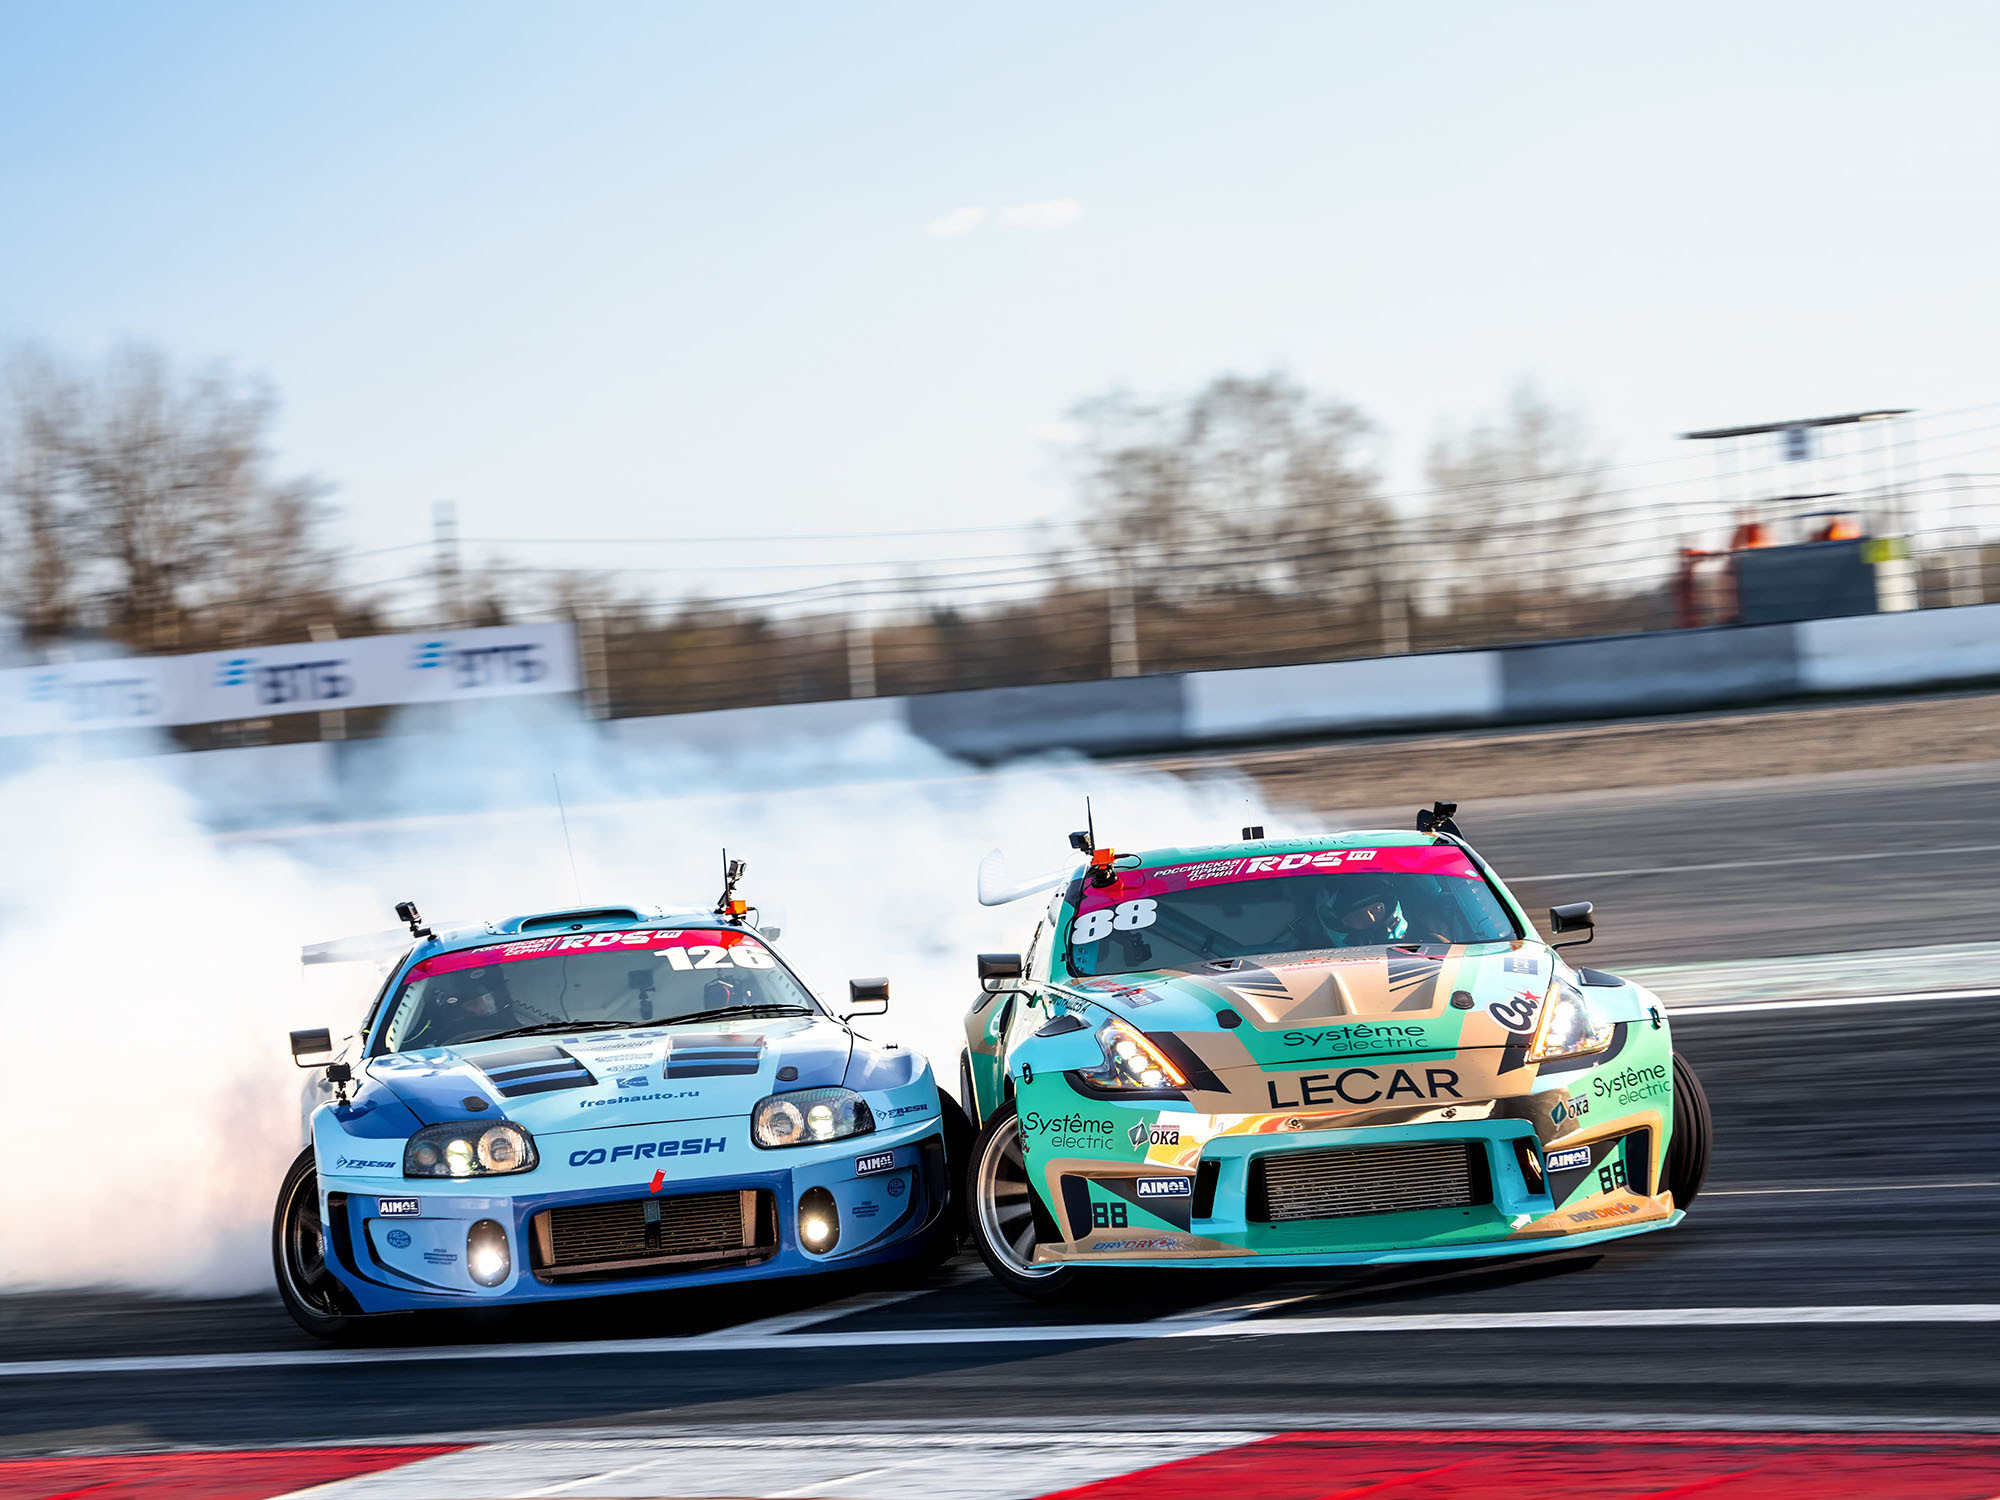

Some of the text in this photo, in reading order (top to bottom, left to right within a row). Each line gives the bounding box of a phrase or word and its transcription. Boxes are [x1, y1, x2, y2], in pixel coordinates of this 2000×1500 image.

[1154, 859, 1241, 877] РОССИЙСКАЯ
[1187, 865, 1236, 877] ДРИФТ
[1245, 850, 1347, 874] RDS
[1189, 870, 1234, 882] СЕРИЯ
[1071, 899, 1157, 945] 88
[557, 930, 658, 950] RDS
[653, 945, 776, 971] 126
[1284, 1024, 1425, 1046] Systême
[1332, 1037, 1428, 1051] electric
[1267, 1068, 1463, 1109] LECAR
[1593, 1065, 1666, 1097] Systême
[580, 1091, 700, 1108] freshauto.ru
[1619, 1080, 1671, 1105] electric
[888, 1104, 928, 1116] FRESH
[1024, 1112, 1114, 1135] Systême
[1051, 1134, 1113, 1150] electric
[348, 1159, 397, 1168] FRESH
[857, 1155, 893, 1172] AIMOL
[1548, 1150, 1589, 1169] AIMOL
[1598, 1159, 1627, 1195] 88
[1139, 1181, 1189, 1195] AIMOL
[380, 1200, 418, 1213] AIMOL
[1092, 1202, 1128, 1228] 88
